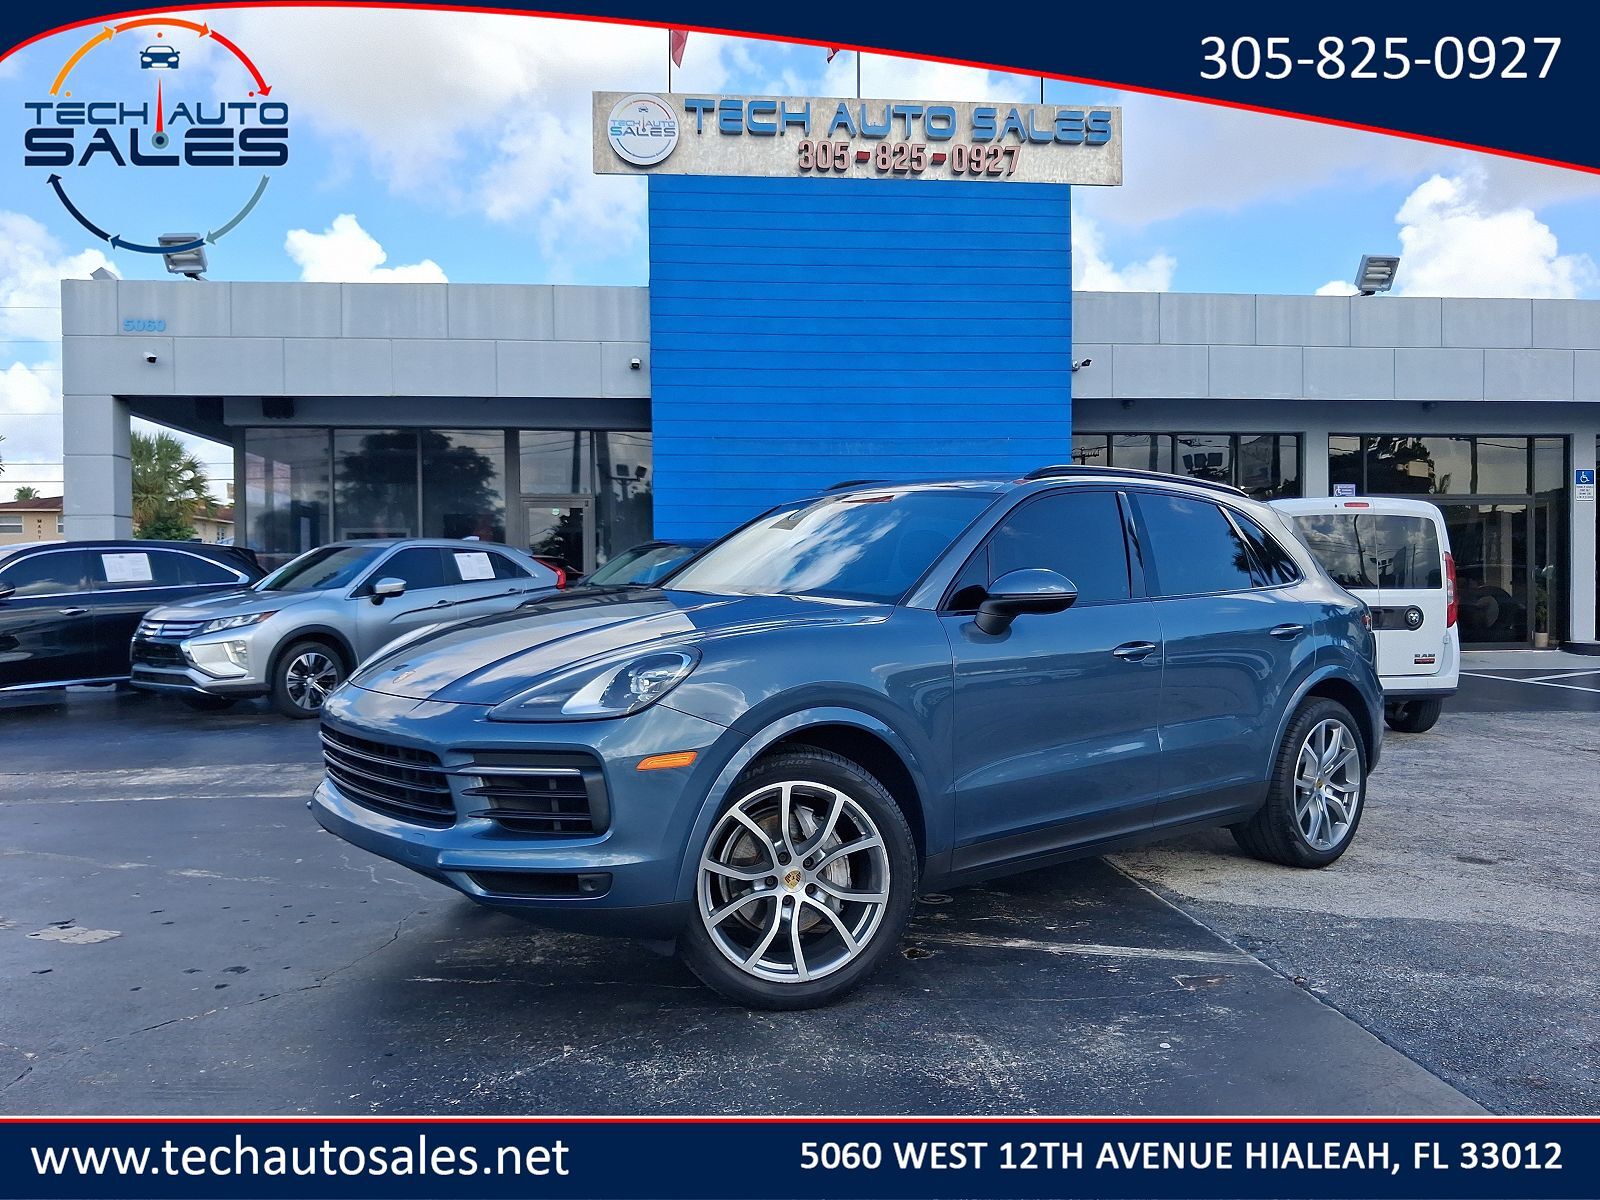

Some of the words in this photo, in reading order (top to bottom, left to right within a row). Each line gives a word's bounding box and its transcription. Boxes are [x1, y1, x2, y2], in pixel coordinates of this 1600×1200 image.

[610, 126, 676, 137] SALES
[611, 119, 640, 127] TECH
[684, 98, 811, 137] TECH
[828, 102, 956, 140] AUTO
[973, 107, 1112, 145] SALES
[799, 140, 1022, 176] 305-825-0927
